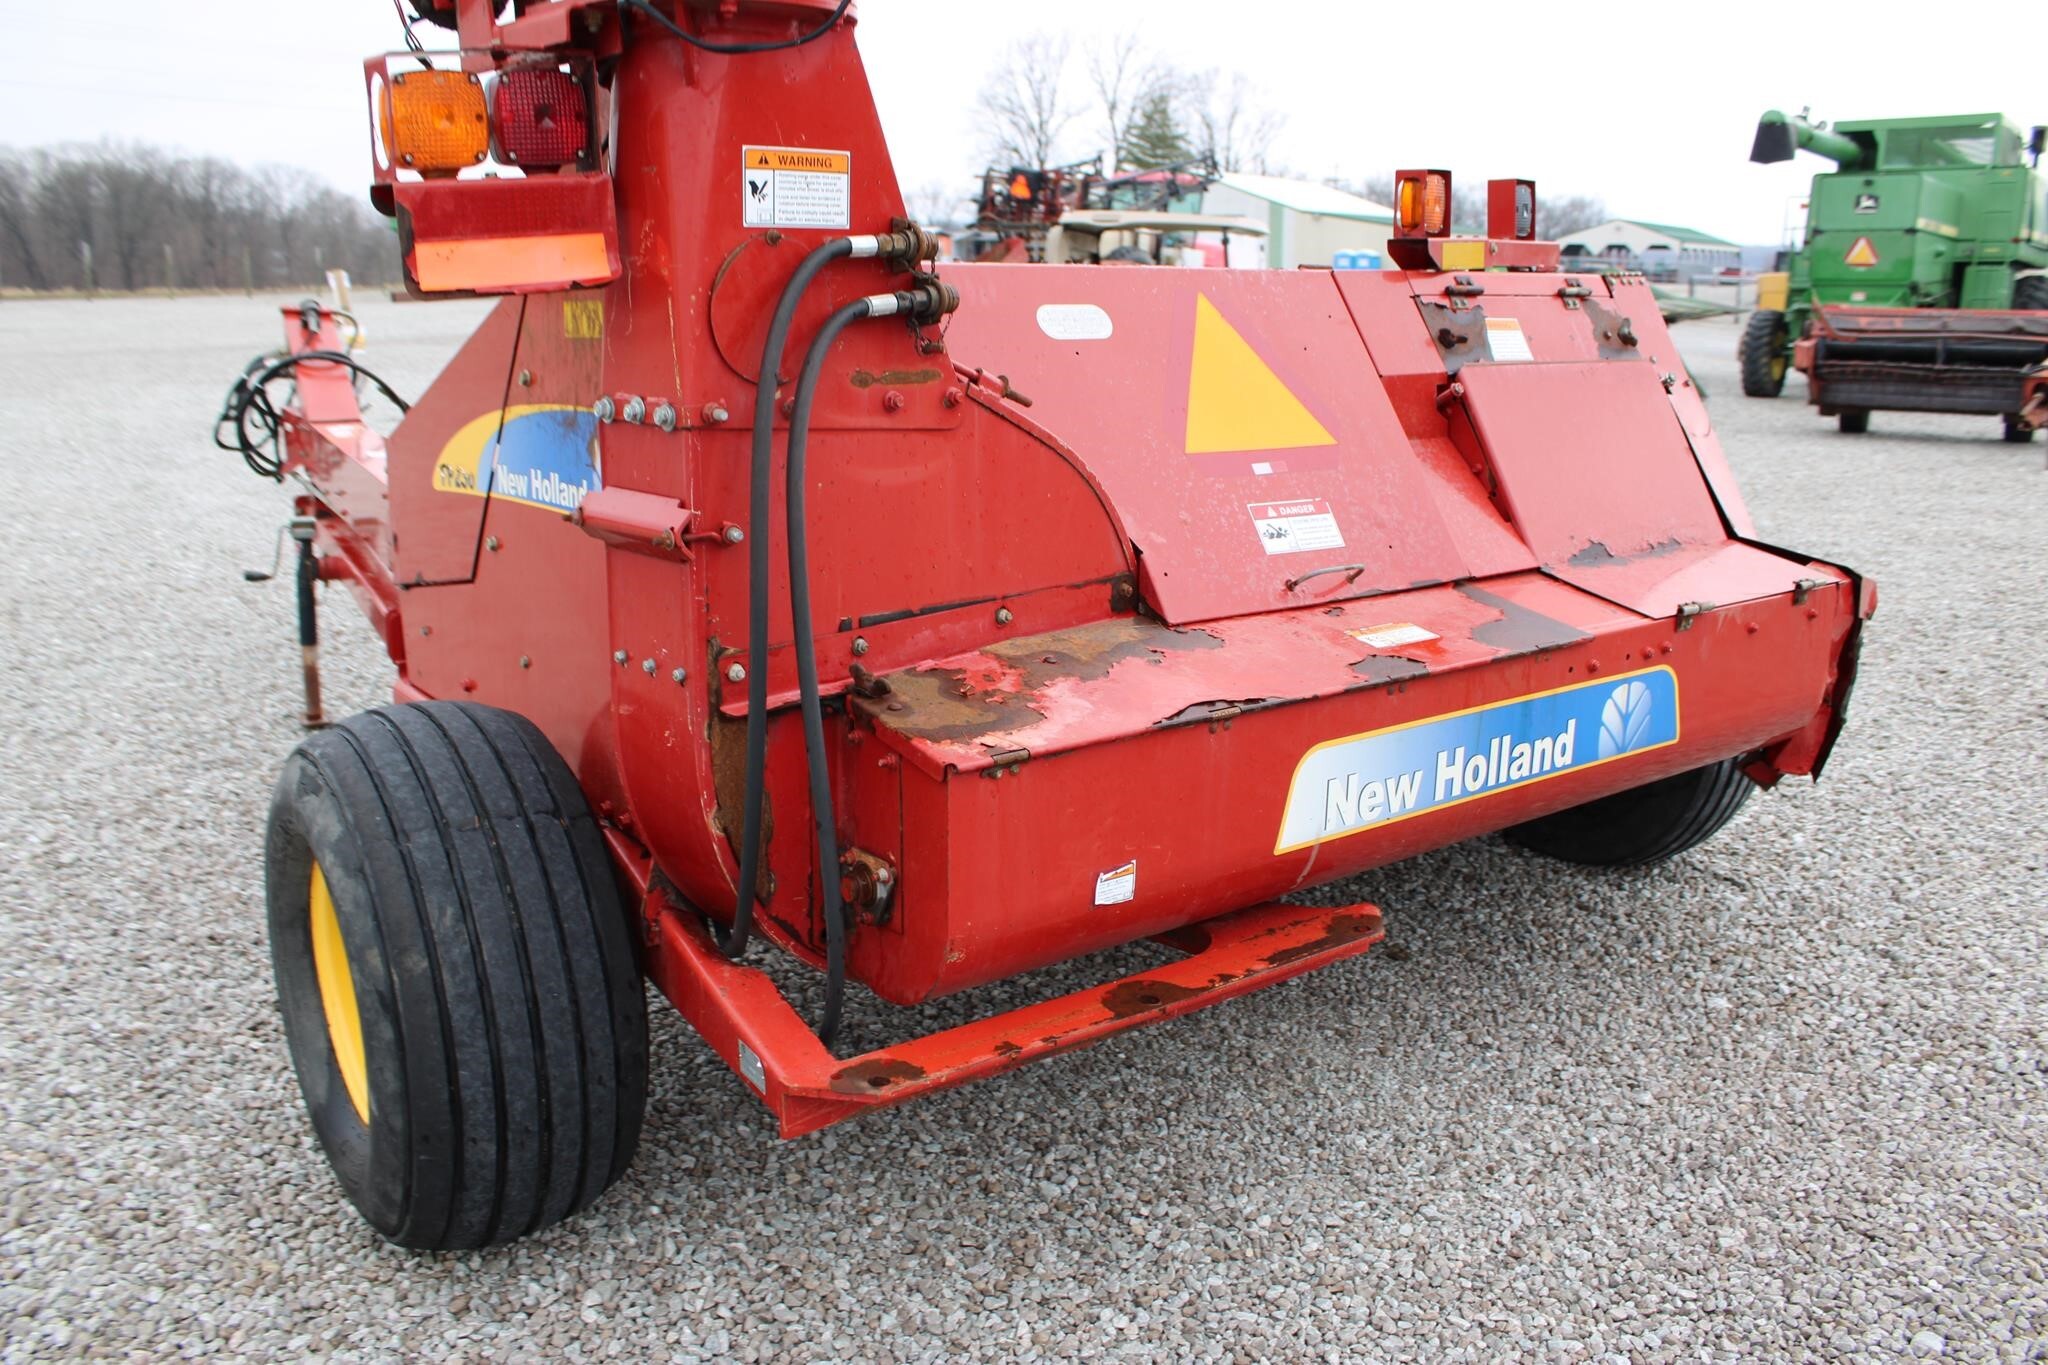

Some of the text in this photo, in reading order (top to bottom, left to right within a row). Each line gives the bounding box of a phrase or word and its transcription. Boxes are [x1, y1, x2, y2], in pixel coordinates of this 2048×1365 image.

[778, 155, 832, 168] WARNING
[497, 464, 588, 508] New Holland
[1280, 504, 1315, 514] DANGER
[1323, 718, 1576, 832] New Holland
